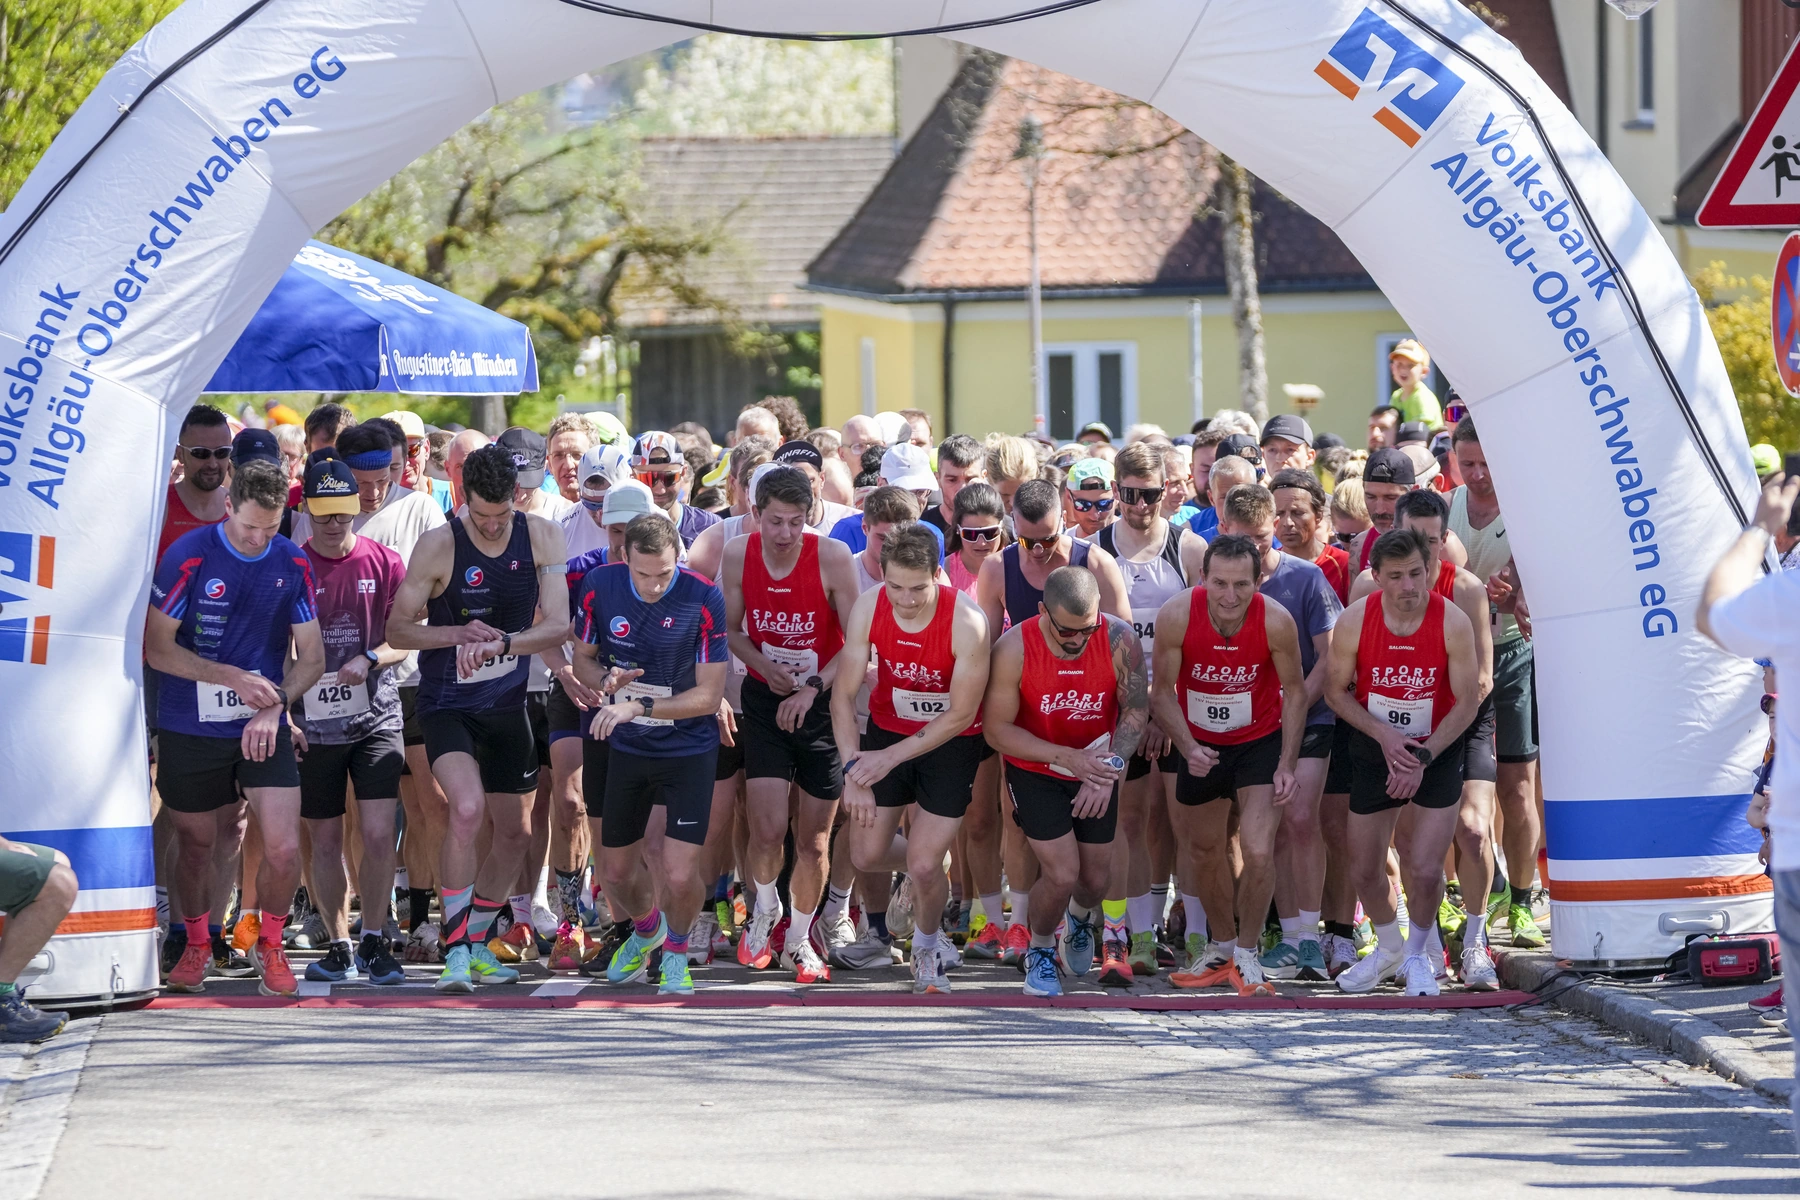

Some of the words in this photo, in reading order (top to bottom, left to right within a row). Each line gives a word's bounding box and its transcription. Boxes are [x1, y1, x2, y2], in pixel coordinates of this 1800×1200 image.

[1475, 111, 1619, 302] Volksbank
[27, 97, 294, 511] Allgäu-Oberschwaben
[293, 45, 348, 99] eG
[472, 352, 518, 377] München
[1430, 151, 1661, 572] Allgäu-Oberschwaben
[1639, 582, 1679, 639] eG
[752, 608, 816, 623] SPORT
[322, 628, 360, 637] Trollinger
[322, 635, 360, 644] Marathon
[896, 639, 922, 648] SALOMON
[1191, 670, 1258, 683] HASCHKO
[1193, 663, 1260, 675] SPORT
[1371, 665, 1437, 677] SPORT
[1372, 674, 1436, 687] HASCHKO
[318, 685, 352, 704] 426
[1041, 689, 1106, 704] SPORT
[910, 701, 945, 712] 102
[1040, 698, 1103, 713] HASCHKO
[1207, 705, 1230, 720] 98
[1388, 710, 1411, 725] 96
